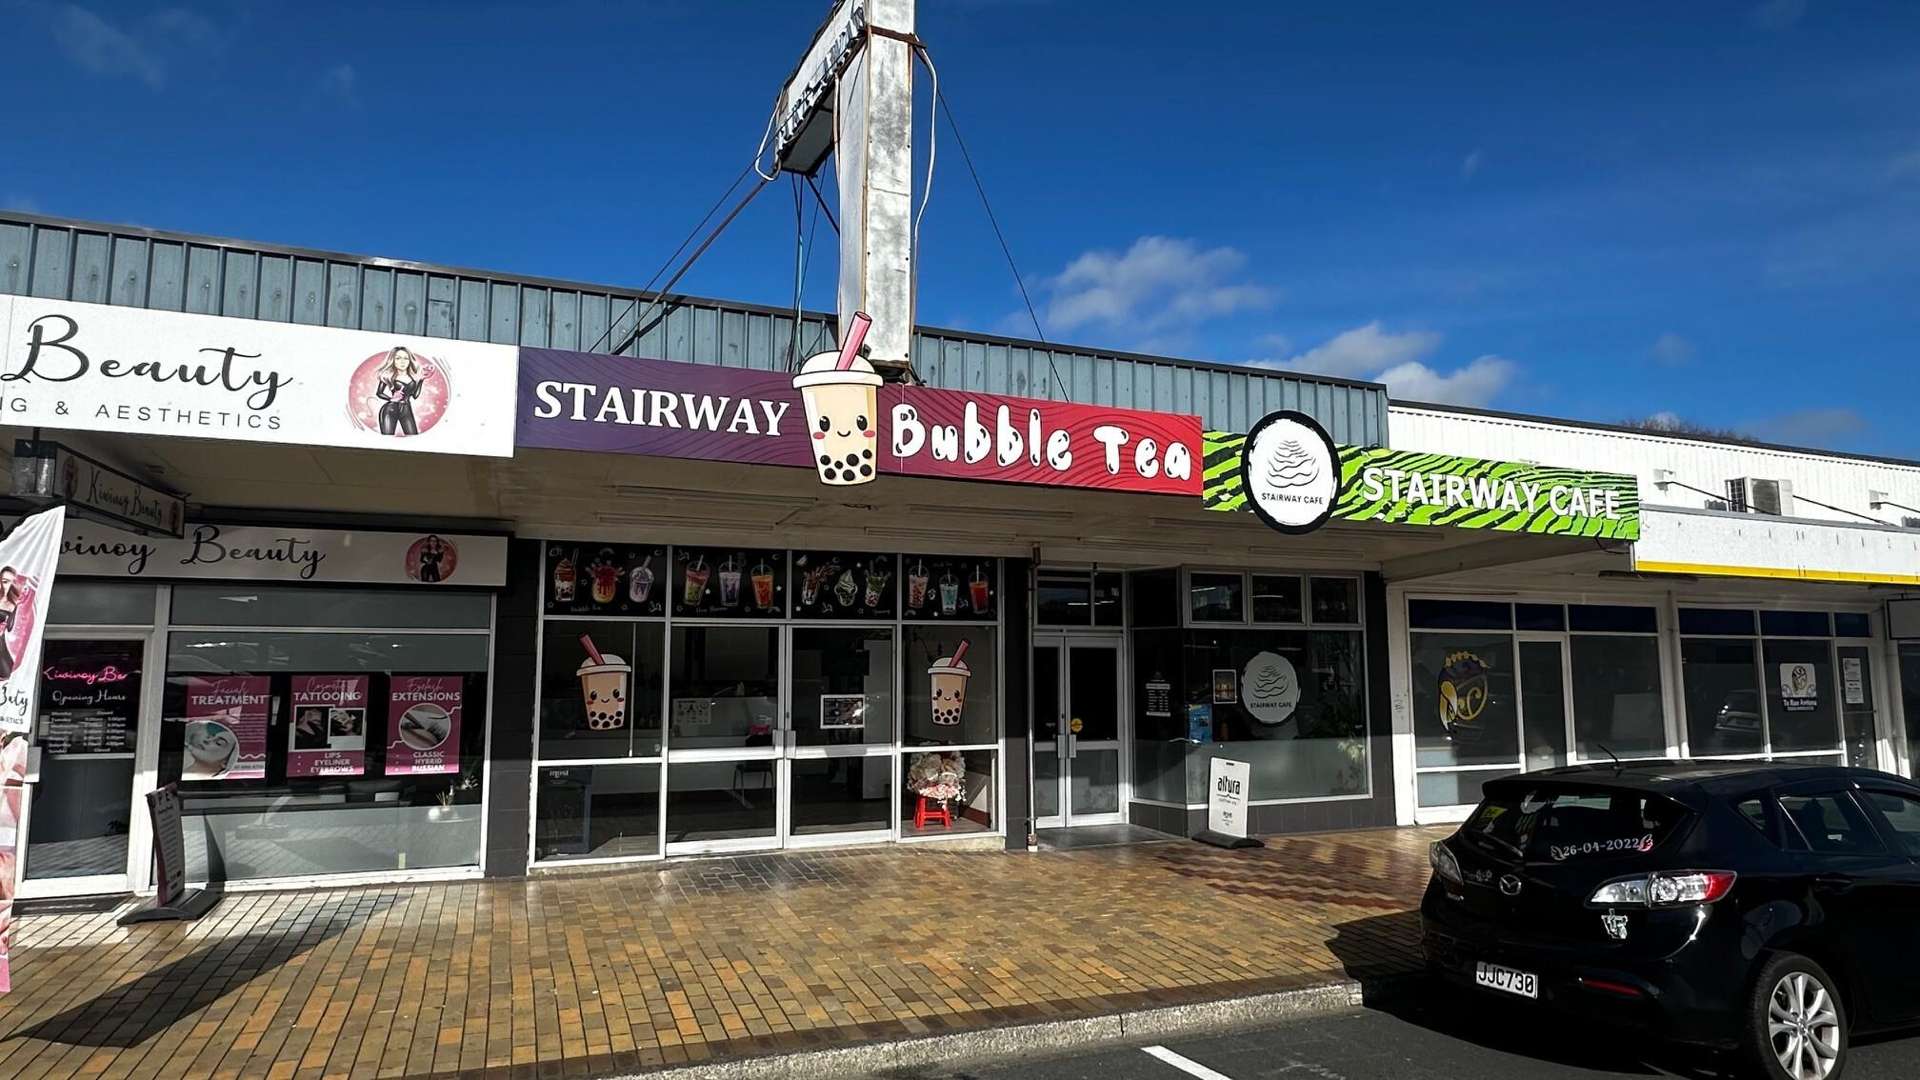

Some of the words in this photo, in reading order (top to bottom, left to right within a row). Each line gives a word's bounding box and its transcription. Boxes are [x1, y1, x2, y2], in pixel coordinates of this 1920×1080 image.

[1, 314, 293, 410] Beauty
[55, 401, 69, 415] &
[95, 404, 282, 430] AESTHETICS
[534, 380, 790, 436] STAIRWAY
[891, 401, 1073, 471] Bubble
[1093, 424, 1192, 481] Tea
[1261, 492, 1302, 503] STAIRWAY
[1303, 496, 1324, 505] CAFE
[1361, 467, 1540, 513] STAIRWAY
[1548, 484, 1621, 520] CAFE
[180, 525, 326, 579] Beauty
[191, 695, 266, 705] TREATMENT
[294, 692, 362, 701] TATTOOING
[392, 692, 461, 701] EXTENSIONS
[1217, 776, 1241, 795] altura
[1563, 838, 1640, 857] 26-04-2022
[1478, 964, 1534, 994] JJC730
